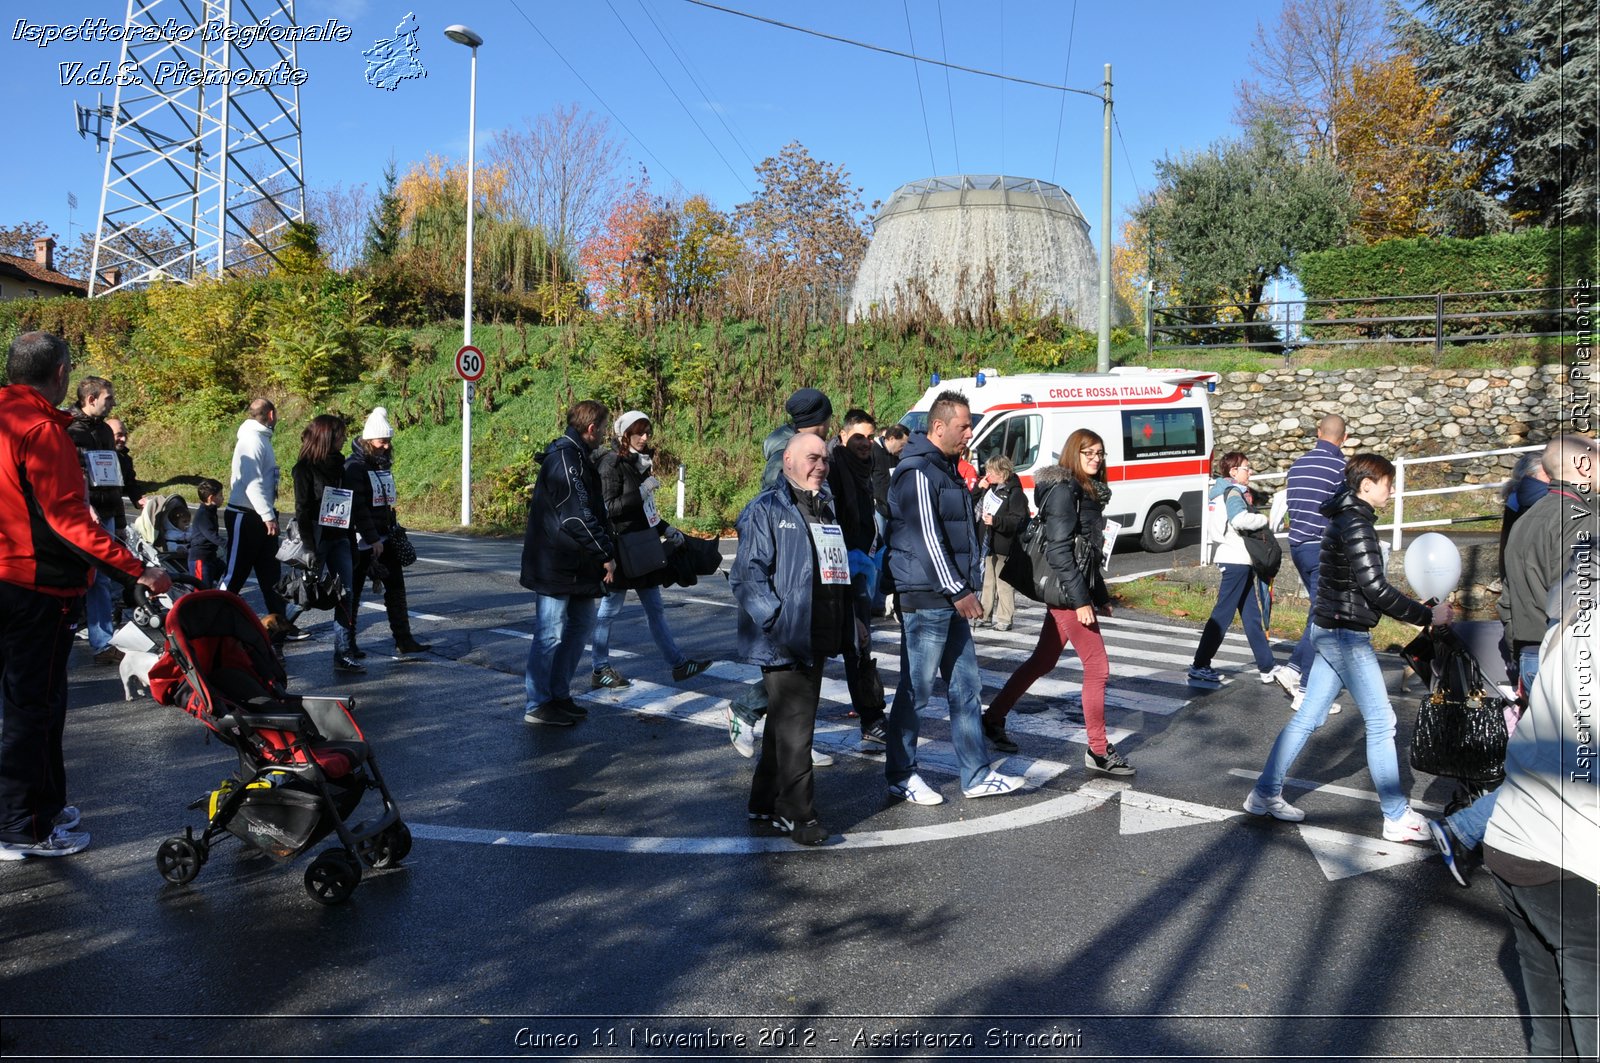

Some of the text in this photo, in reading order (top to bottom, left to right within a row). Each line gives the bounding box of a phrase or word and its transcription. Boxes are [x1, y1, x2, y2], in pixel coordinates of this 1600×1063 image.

[463, 355, 479, 372] 50
[1049, 386, 1163, 399] CROCE ROSSA ITALIANA
[326, 502, 345, 515] 1473
[823, 546, 843, 564] 1450
